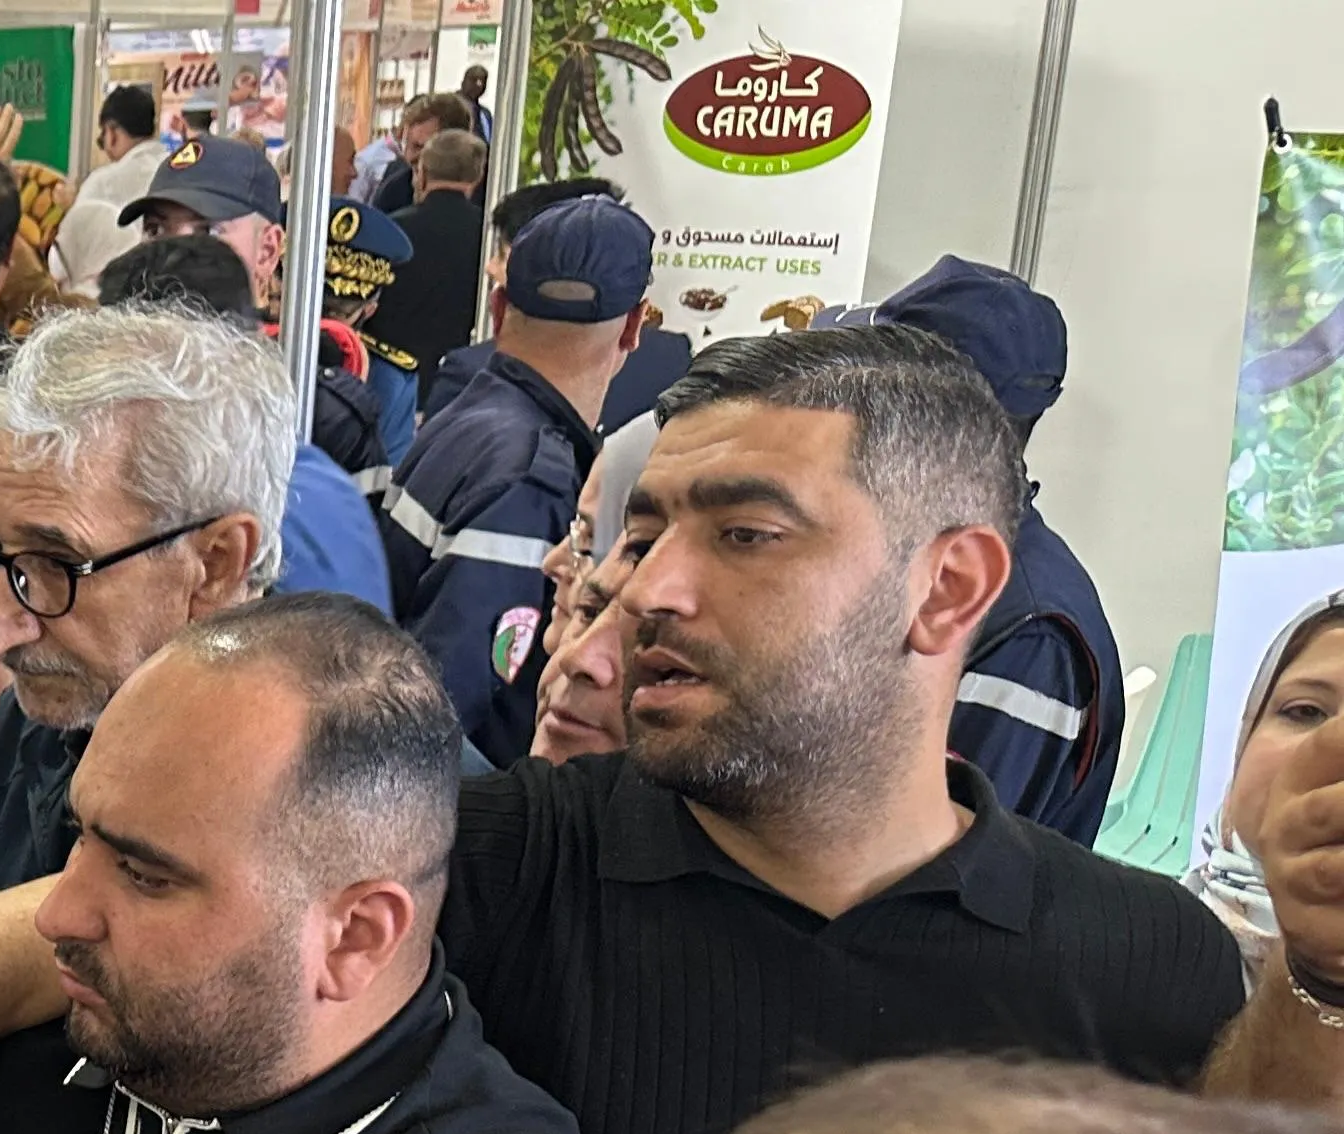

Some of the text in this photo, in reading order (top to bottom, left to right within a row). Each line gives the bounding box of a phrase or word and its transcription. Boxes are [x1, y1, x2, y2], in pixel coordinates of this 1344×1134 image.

[714, 66, 824, 103] كاروما
[696, 106, 834, 140] CARUMA
[721, 156, 792, 174] Carob
[676, 229, 745, 248] مسحوق
[750, 230, 840, 256] إستعمالات
[688, 254, 768, 272] EXTRACT
[776, 259, 822, 275] USES
